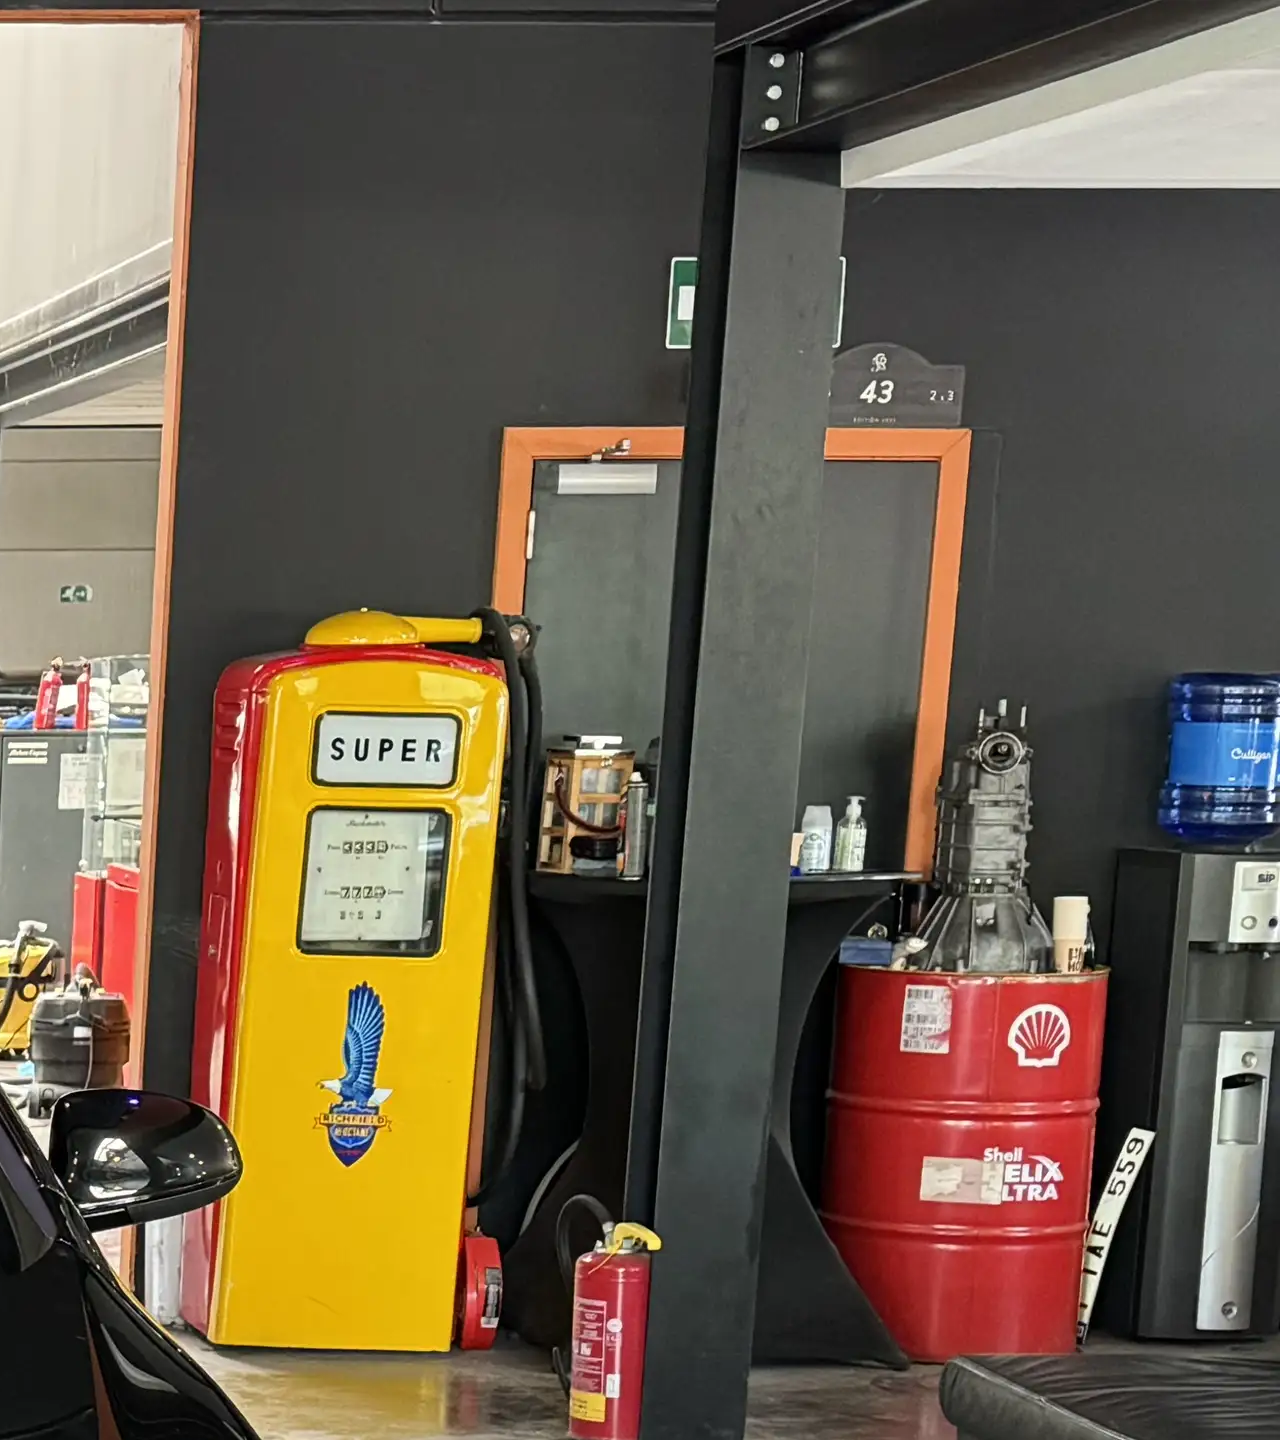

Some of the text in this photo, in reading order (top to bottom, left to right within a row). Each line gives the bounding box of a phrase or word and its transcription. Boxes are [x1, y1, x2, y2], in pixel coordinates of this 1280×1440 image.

[859, 380, 895, 404] 43
[330, 737, 442, 763] SUPER
[1230, 747, 1272, 765] Culligan
[983, 1146, 1024, 1163] Shell
[1107, 1136, 1145, 1197] 559
[1005, 1155, 1065, 1183] ELIX
[1002, 1183, 1059, 1202] LTRA
